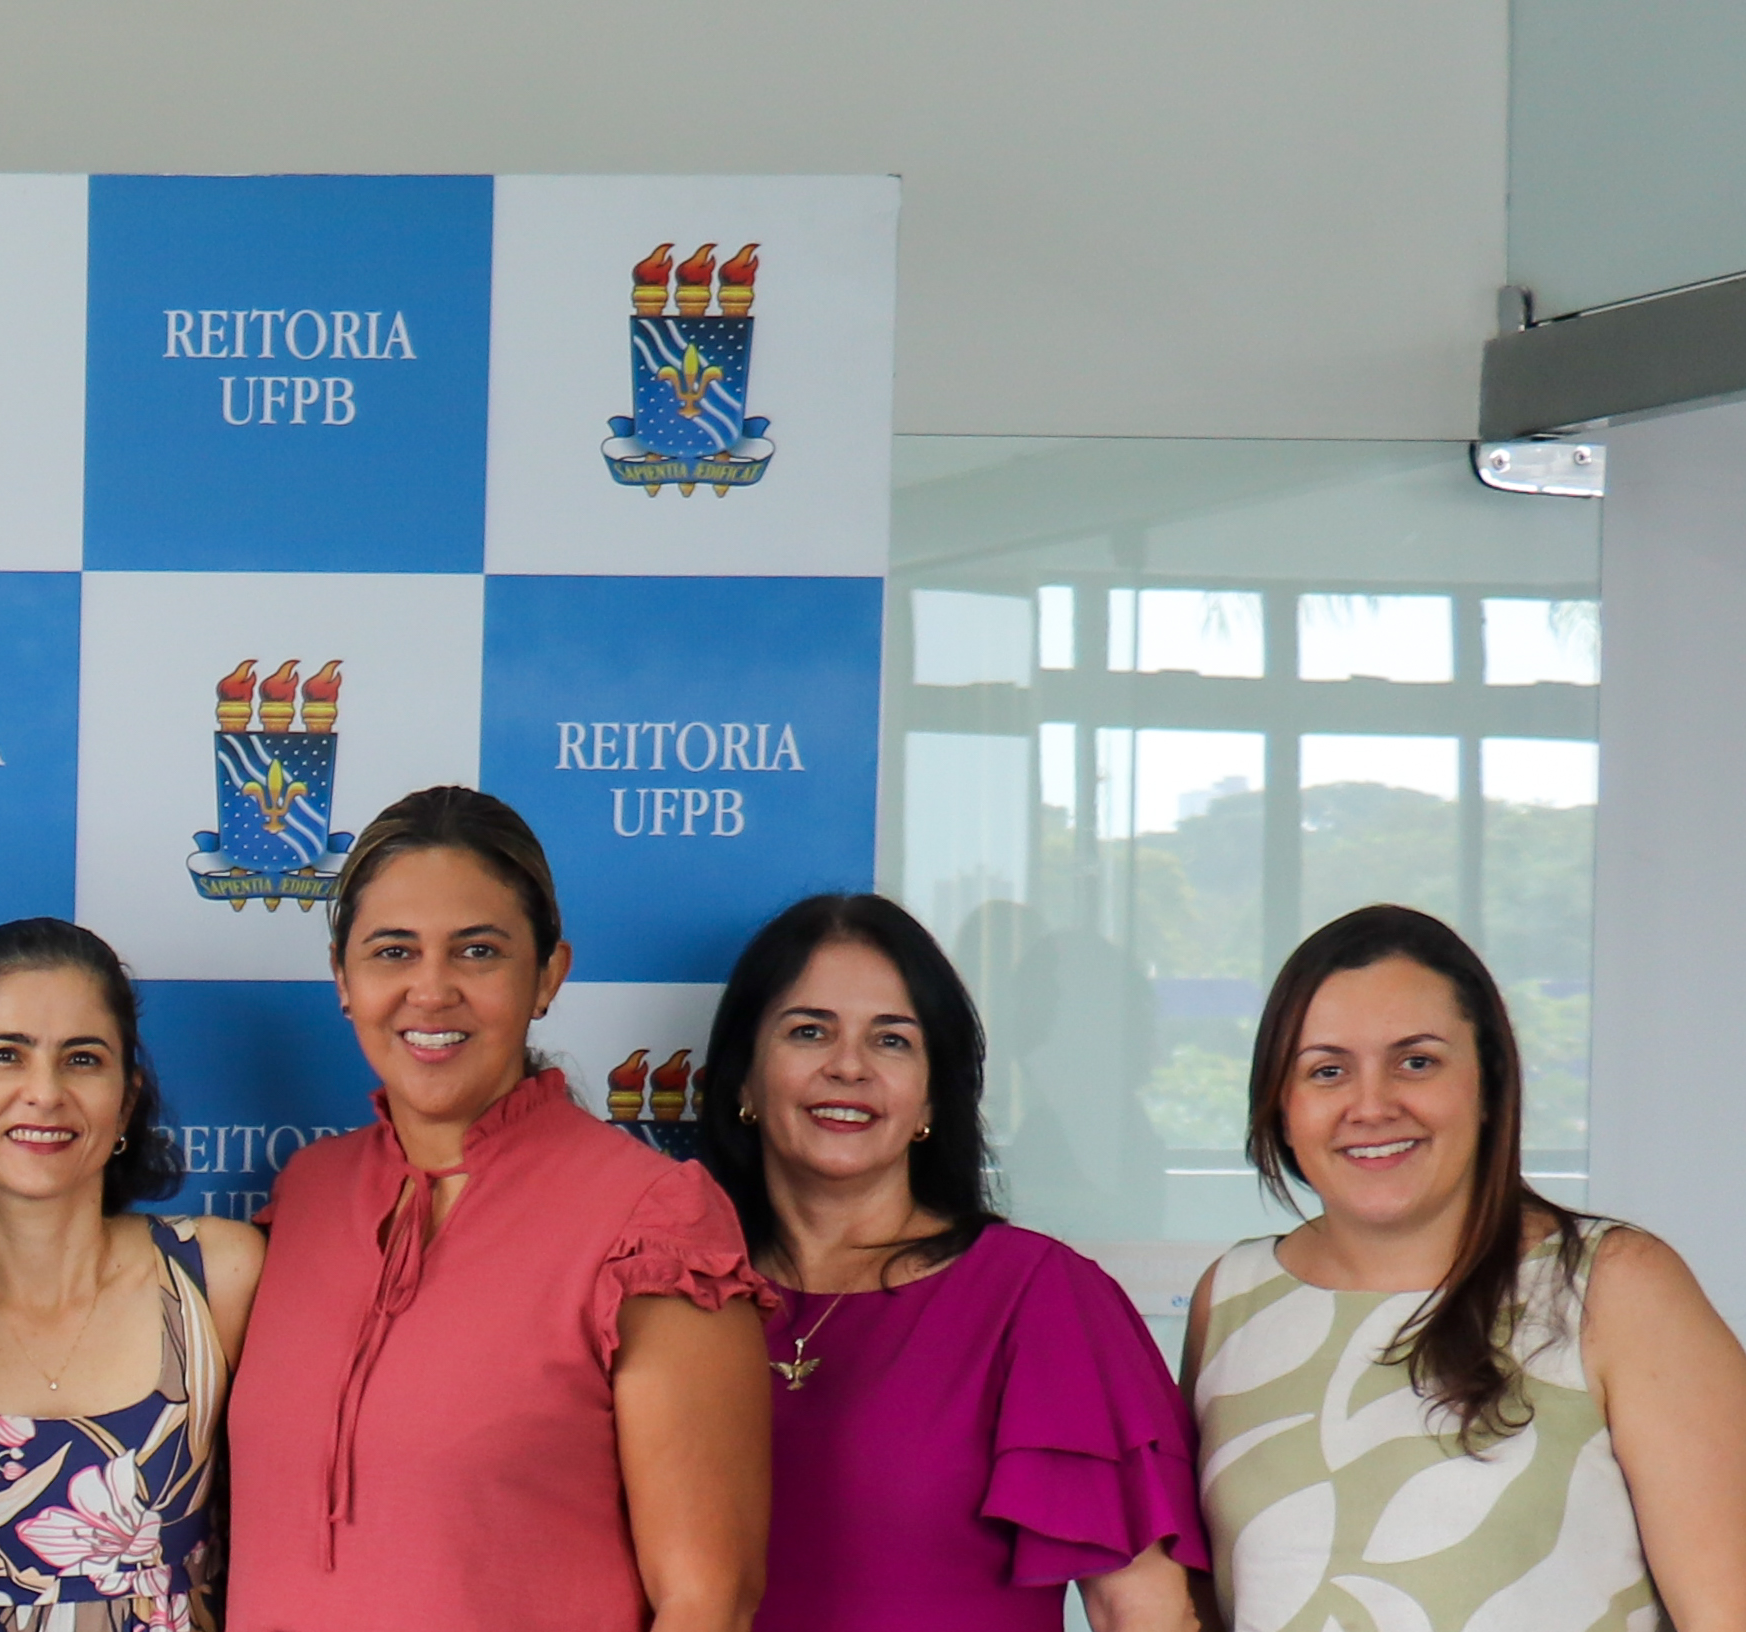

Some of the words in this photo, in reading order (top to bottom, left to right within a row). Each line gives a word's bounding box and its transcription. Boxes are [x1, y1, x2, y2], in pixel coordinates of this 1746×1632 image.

[163, 309, 417, 360] REITORIA
[220, 376, 356, 425] UFPB
[555, 721, 805, 772] REITORIA
[610, 788, 745, 837] UFPB
